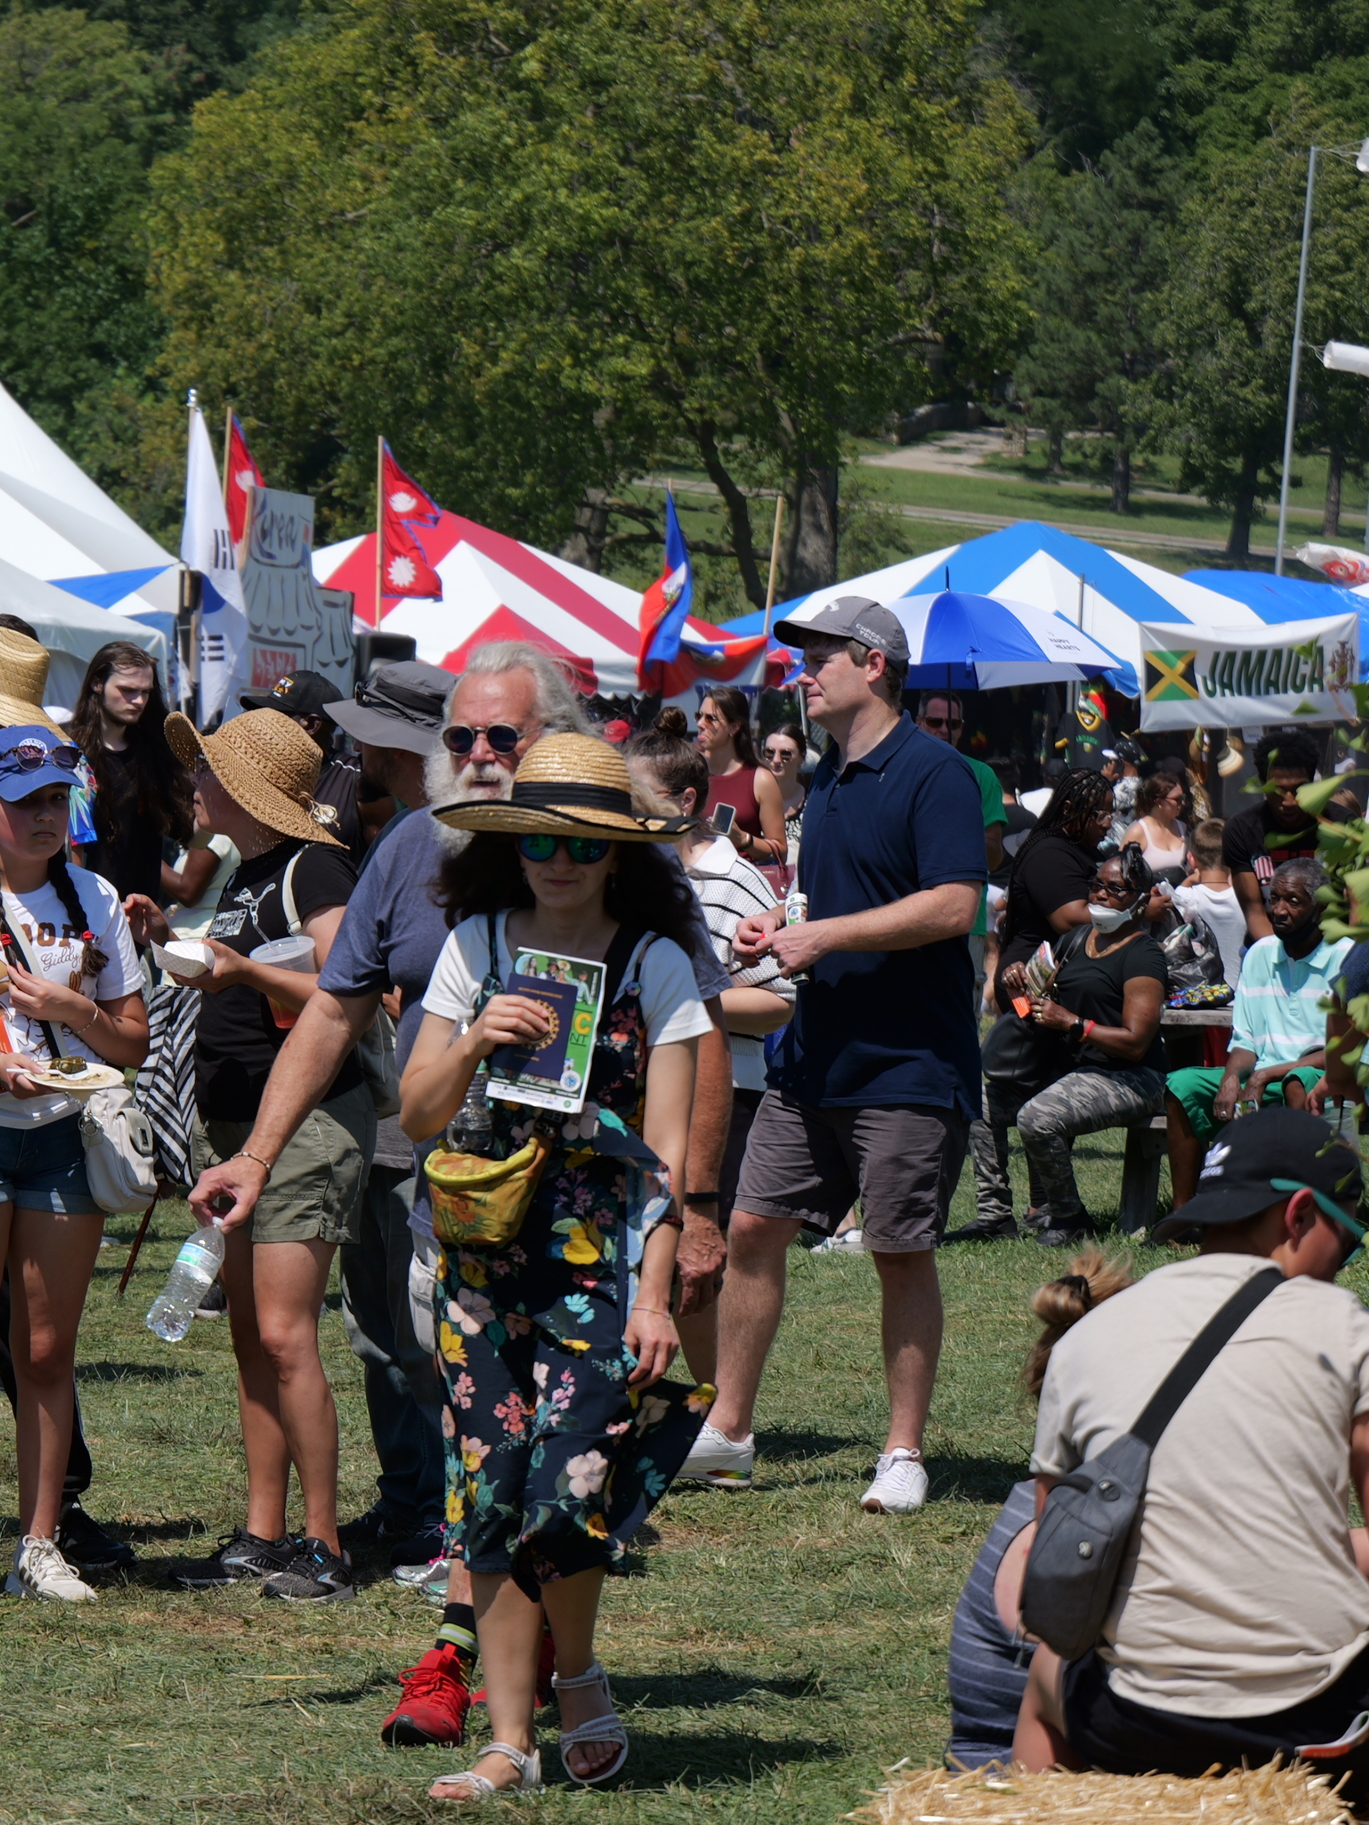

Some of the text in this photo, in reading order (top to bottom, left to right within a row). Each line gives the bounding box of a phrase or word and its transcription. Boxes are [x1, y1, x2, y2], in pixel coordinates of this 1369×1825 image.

[855, 623, 887, 646] CHROME
[859, 630, 880, 646] TOUR
[1201, 645, 1324, 698] JAMAICA
